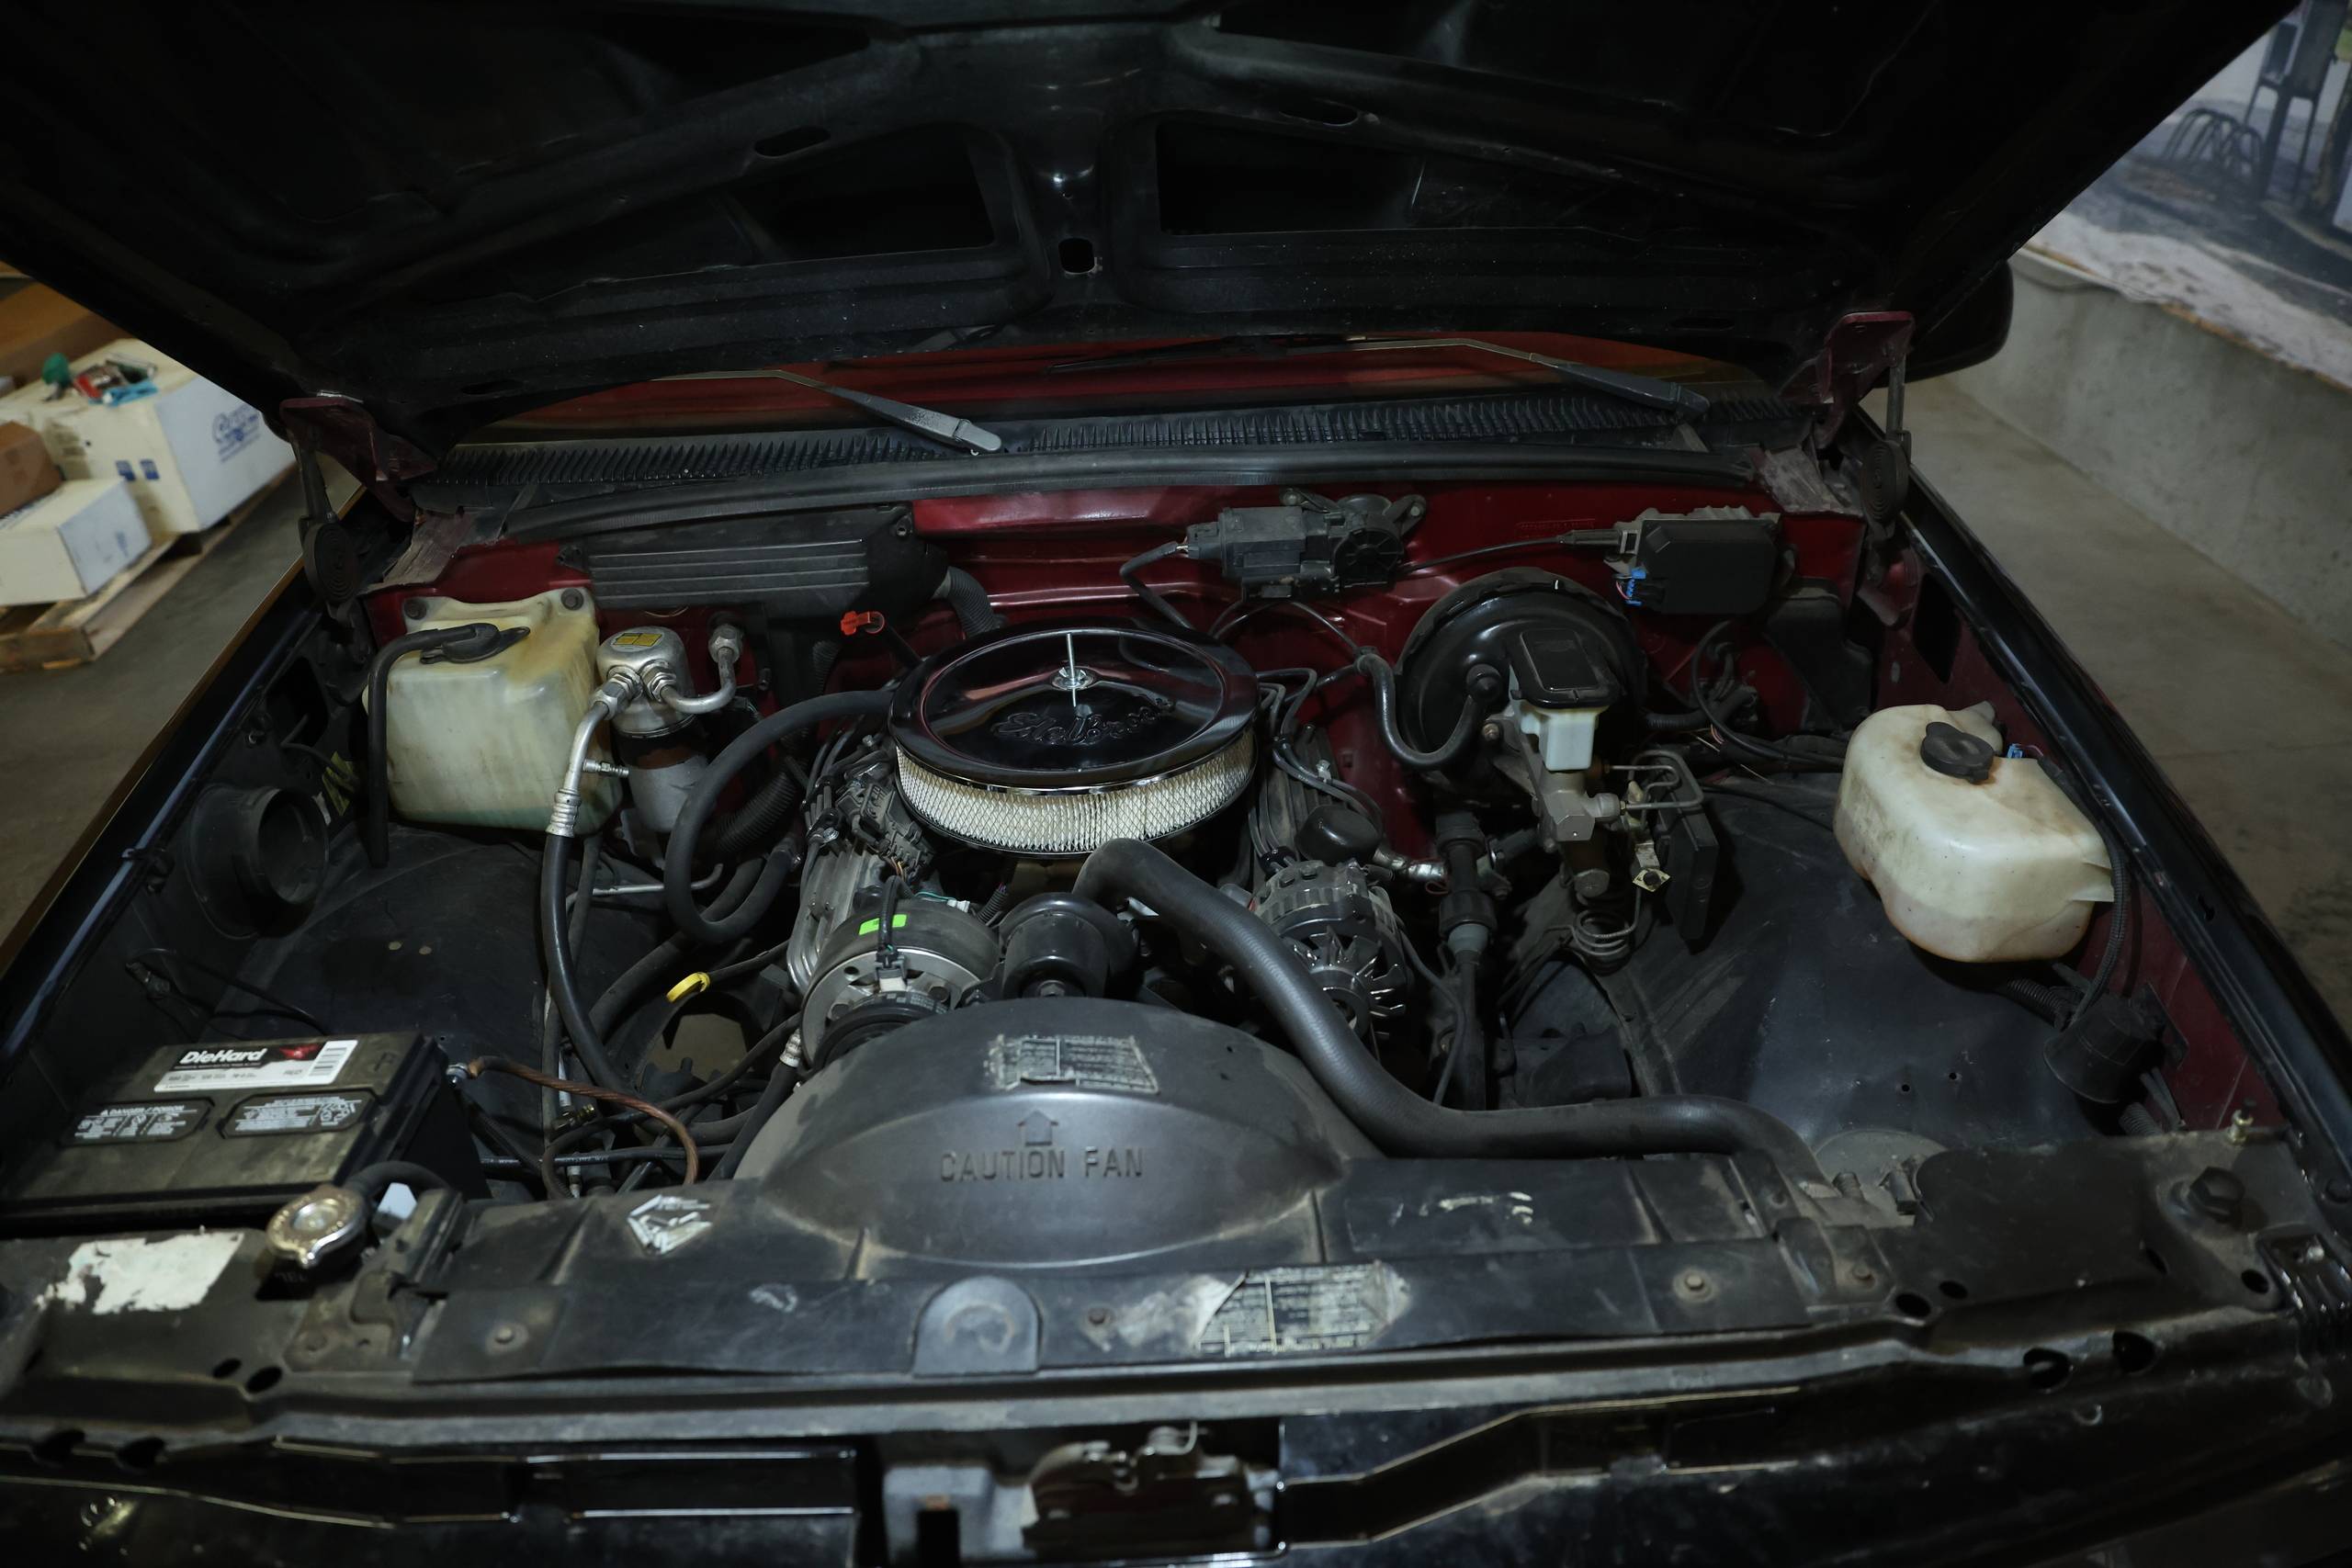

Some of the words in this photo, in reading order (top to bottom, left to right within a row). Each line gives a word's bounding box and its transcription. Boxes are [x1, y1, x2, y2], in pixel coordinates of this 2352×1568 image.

[179, 1047, 267, 1064] DieHard
[940, 1149, 1065, 1181] CAUTION
[1084, 1146, 1144, 1178] FAN
